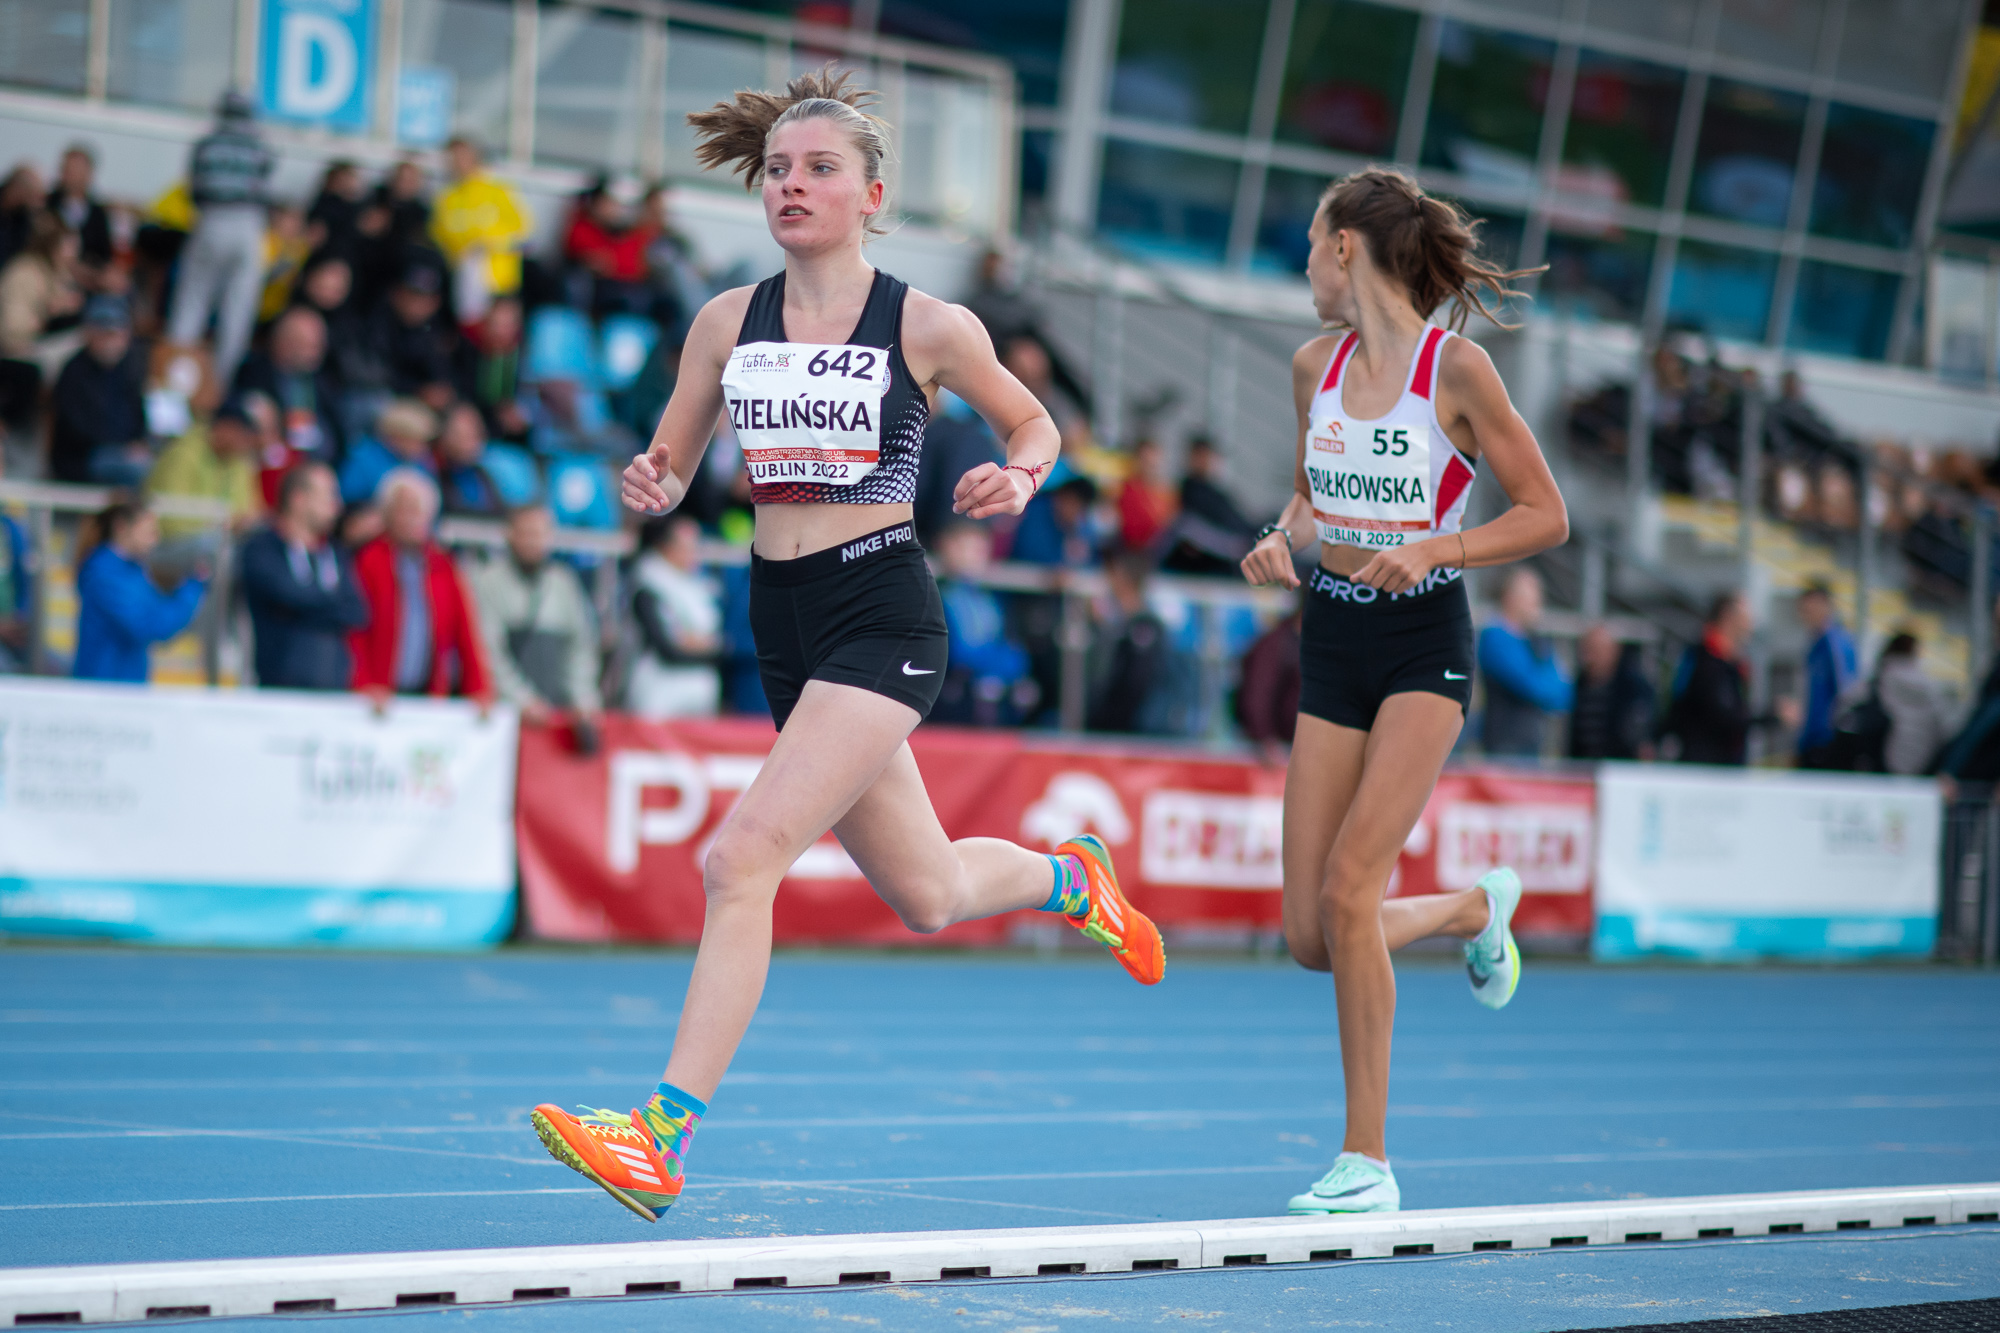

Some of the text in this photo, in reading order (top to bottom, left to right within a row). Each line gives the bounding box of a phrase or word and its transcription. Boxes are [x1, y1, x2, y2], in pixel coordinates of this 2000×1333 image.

[277, 12, 358, 116] D
[807, 350, 876, 381] 642
[730, 393, 872, 432] ZIELIŃSKA
[1315, 438, 1343, 453] ORLEN
[1372, 428, 1409, 457] 55
[751, 462, 848, 478] LUBLIN 2022
[1308, 466, 1426, 504] BUŁKOWSKA
[842, 526, 912, 563] NIKE PRO
[1324, 525, 1404, 546] LUBLIN 2022
[1316, 574, 1378, 604] PRO
